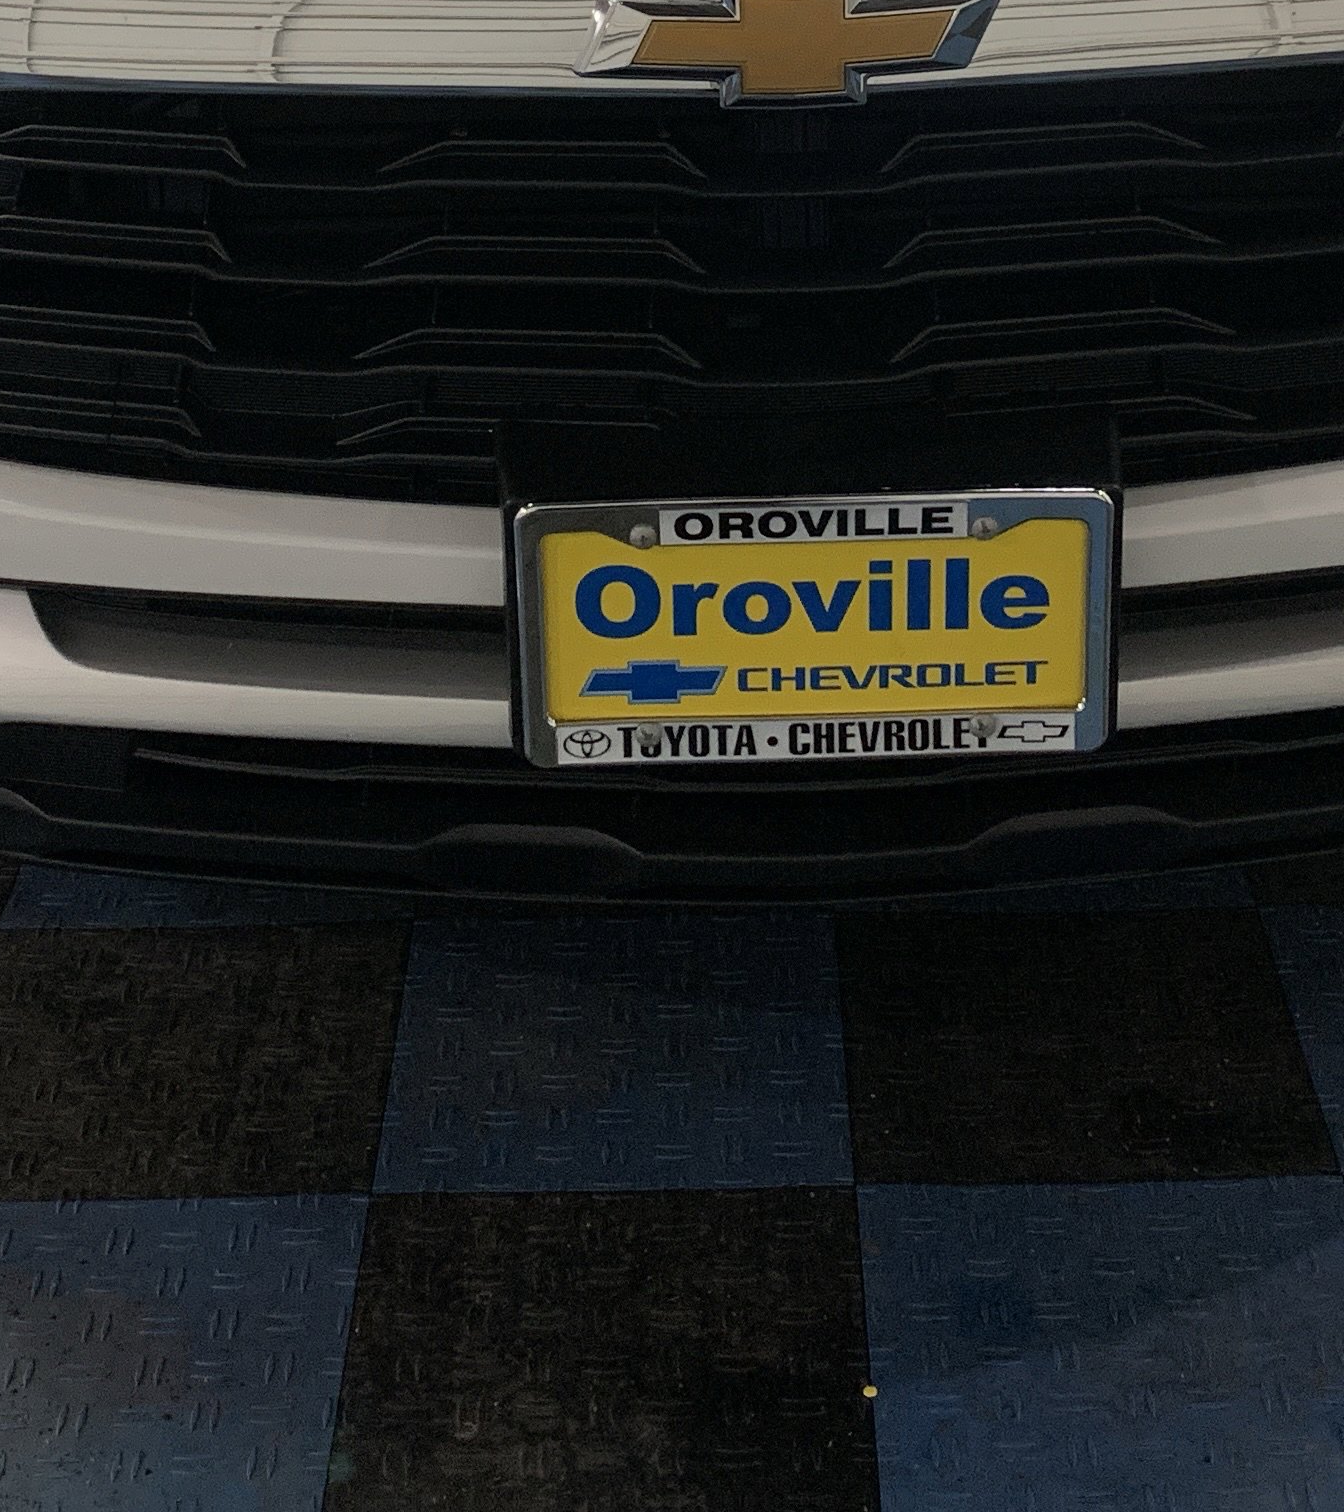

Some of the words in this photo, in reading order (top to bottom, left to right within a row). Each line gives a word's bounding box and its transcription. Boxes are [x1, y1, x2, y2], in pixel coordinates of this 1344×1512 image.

[673, 506, 955, 542] OROVILLE
[574, 557, 1051, 640] Oroville
[737, 660, 1050, 693] CHEVROLET
